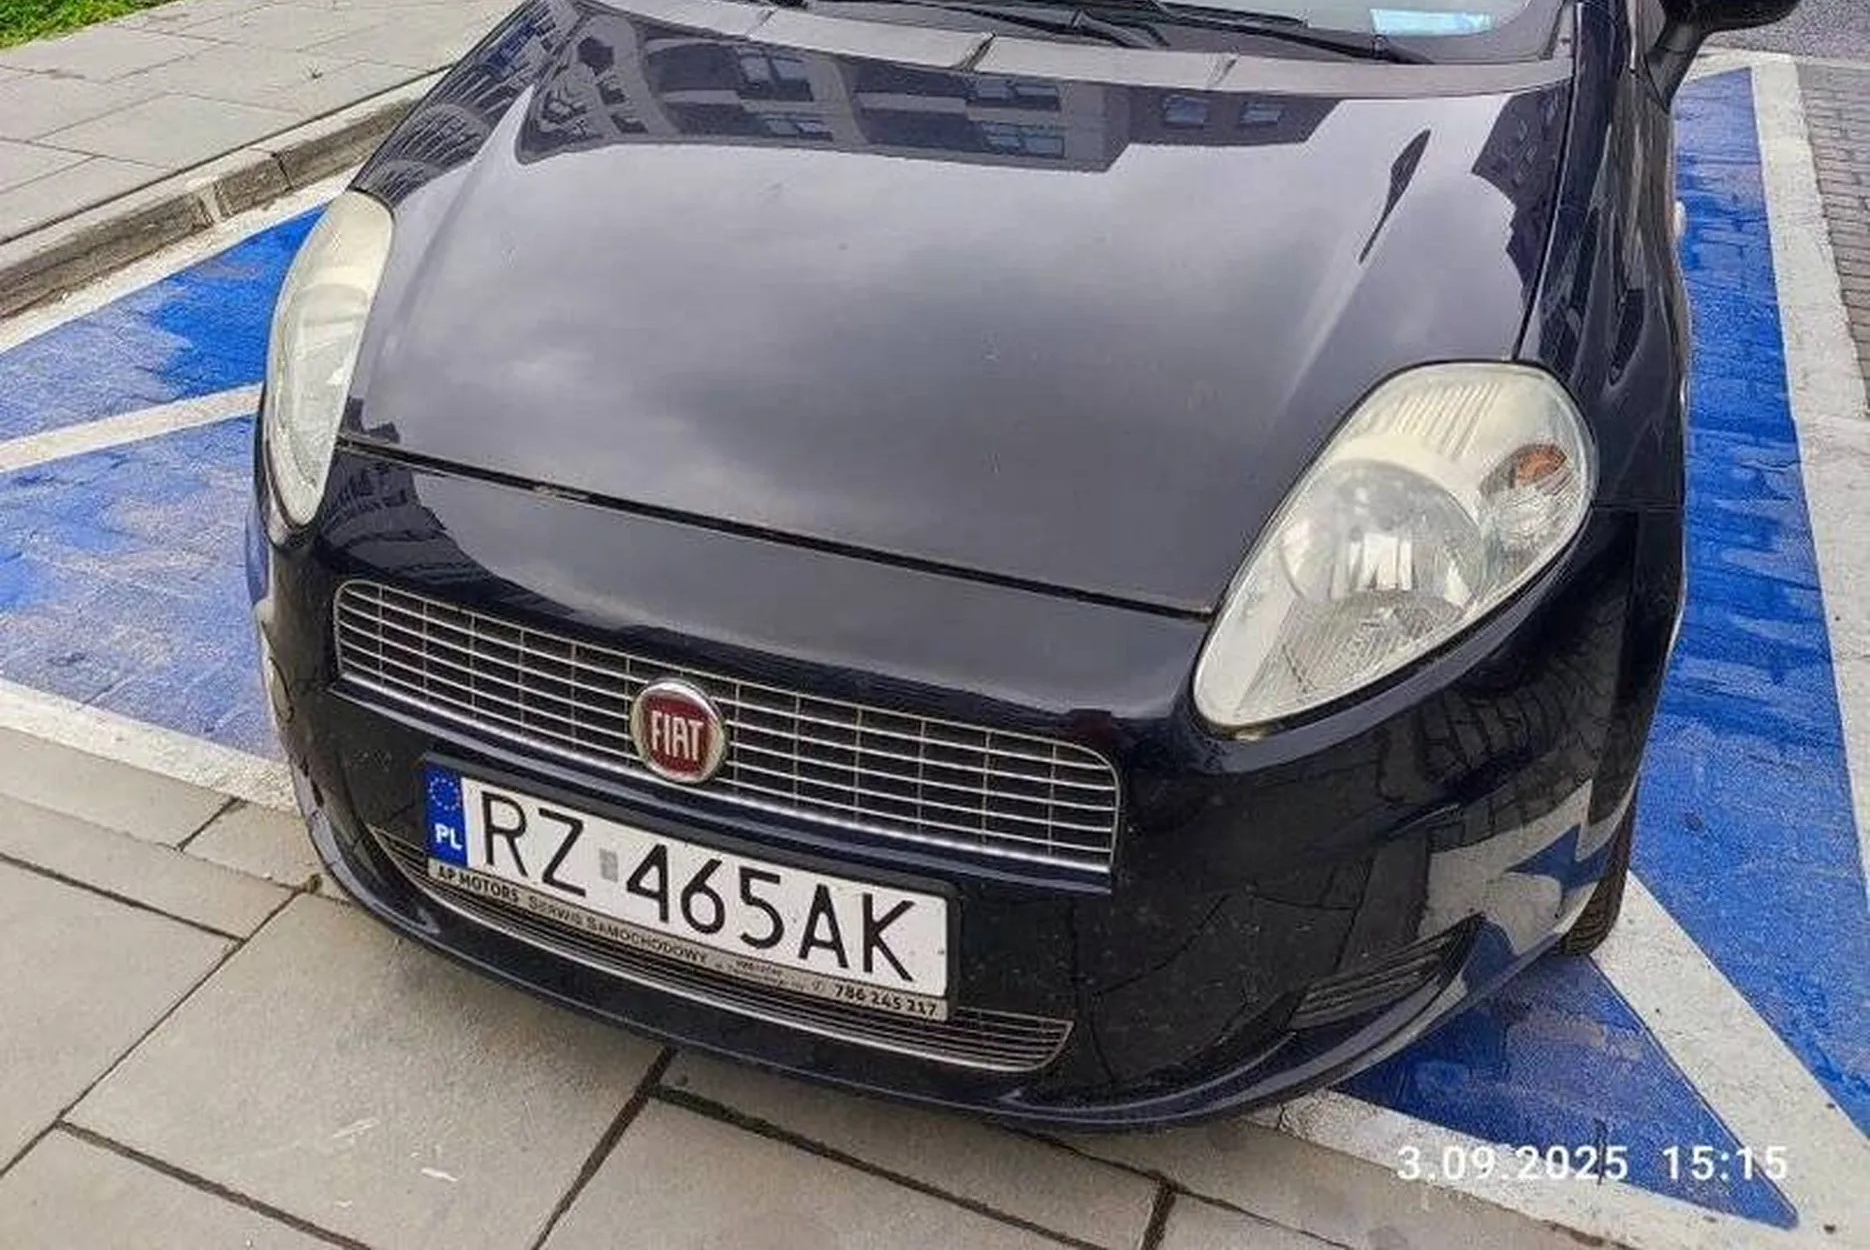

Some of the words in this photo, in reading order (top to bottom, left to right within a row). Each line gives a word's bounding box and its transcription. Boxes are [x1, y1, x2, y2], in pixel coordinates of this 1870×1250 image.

[651, 710, 704, 762] FIAT
[435, 824, 463, 850] PL
[459, 868, 520, 901] MOTORS
[481, 790, 587, 898] RZ
[626, 843, 914, 982] 465AK
